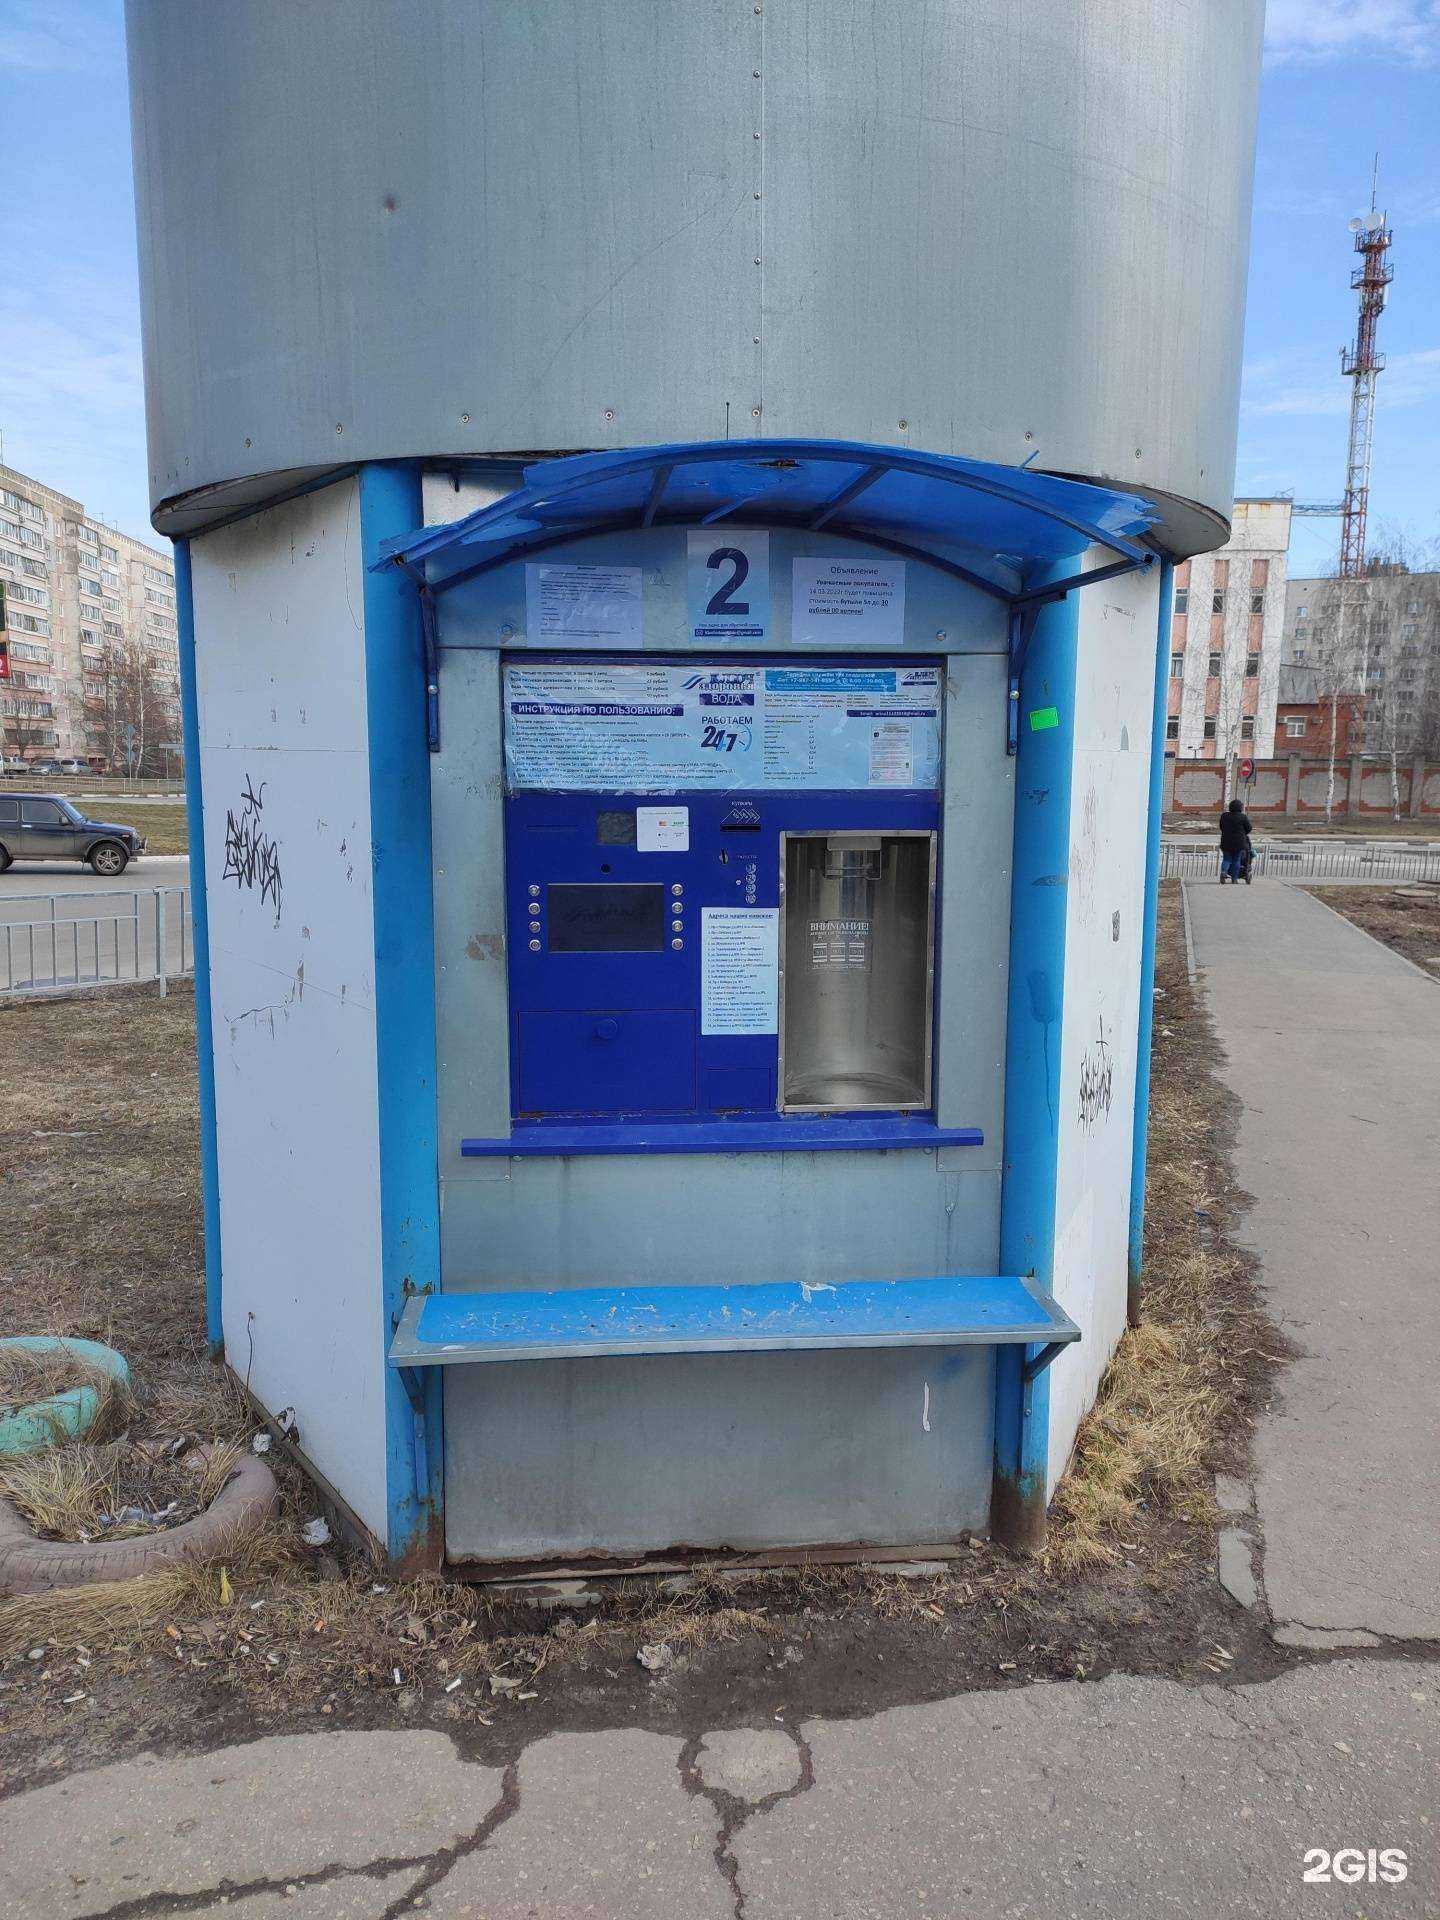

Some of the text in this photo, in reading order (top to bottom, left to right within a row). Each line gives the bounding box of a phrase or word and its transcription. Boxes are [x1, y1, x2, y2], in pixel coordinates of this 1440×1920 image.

[830, 566, 879, 575] Объявление
[705, 547, 750, 615] 2
[816, 579, 852, 587] Уважаемые
[711, 694, 742, 704] ВОДА
[518, 703, 676, 715] ИНСТРУКЦИЯ ПО ПОЛЬЗОВАНИЮ:
[701, 716, 753, 724] РАБОТАЕМ
[810, 922, 870, 931] ВНИМАНИЕ!
